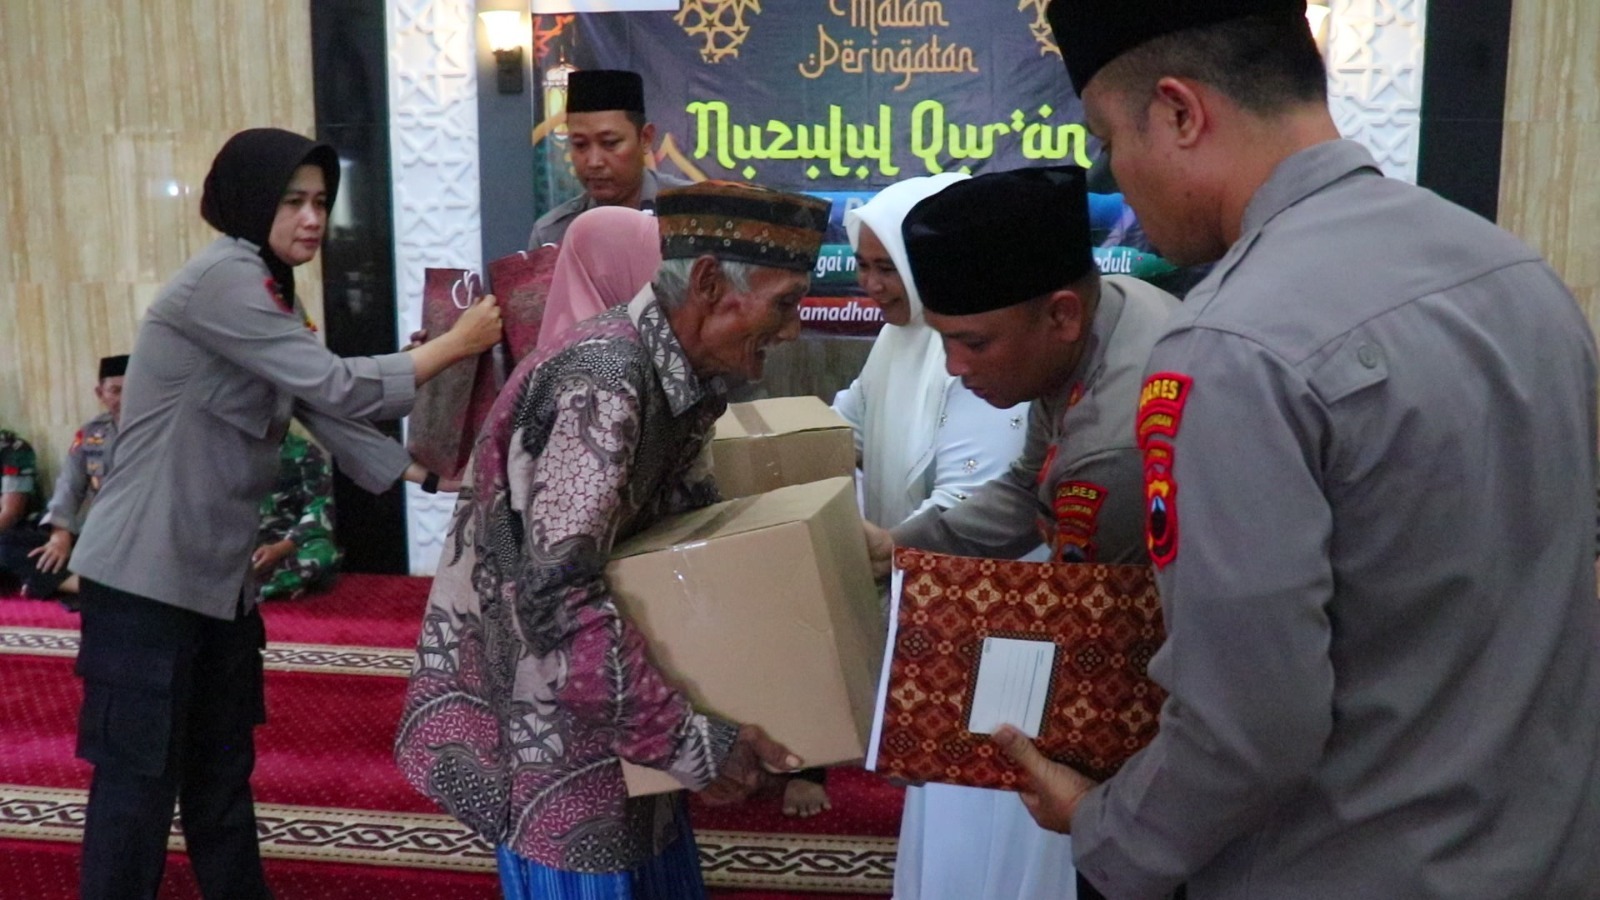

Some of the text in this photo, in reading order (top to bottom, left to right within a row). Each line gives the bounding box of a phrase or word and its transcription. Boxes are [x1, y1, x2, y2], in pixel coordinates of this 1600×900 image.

[829, 0, 950, 36] Malam
[686, 101, 900, 180] Nuzulul
[814, 250, 842, 278] gai
[1093, 250, 1132, 273] eduli
[797, 301, 885, 321] amadhan
